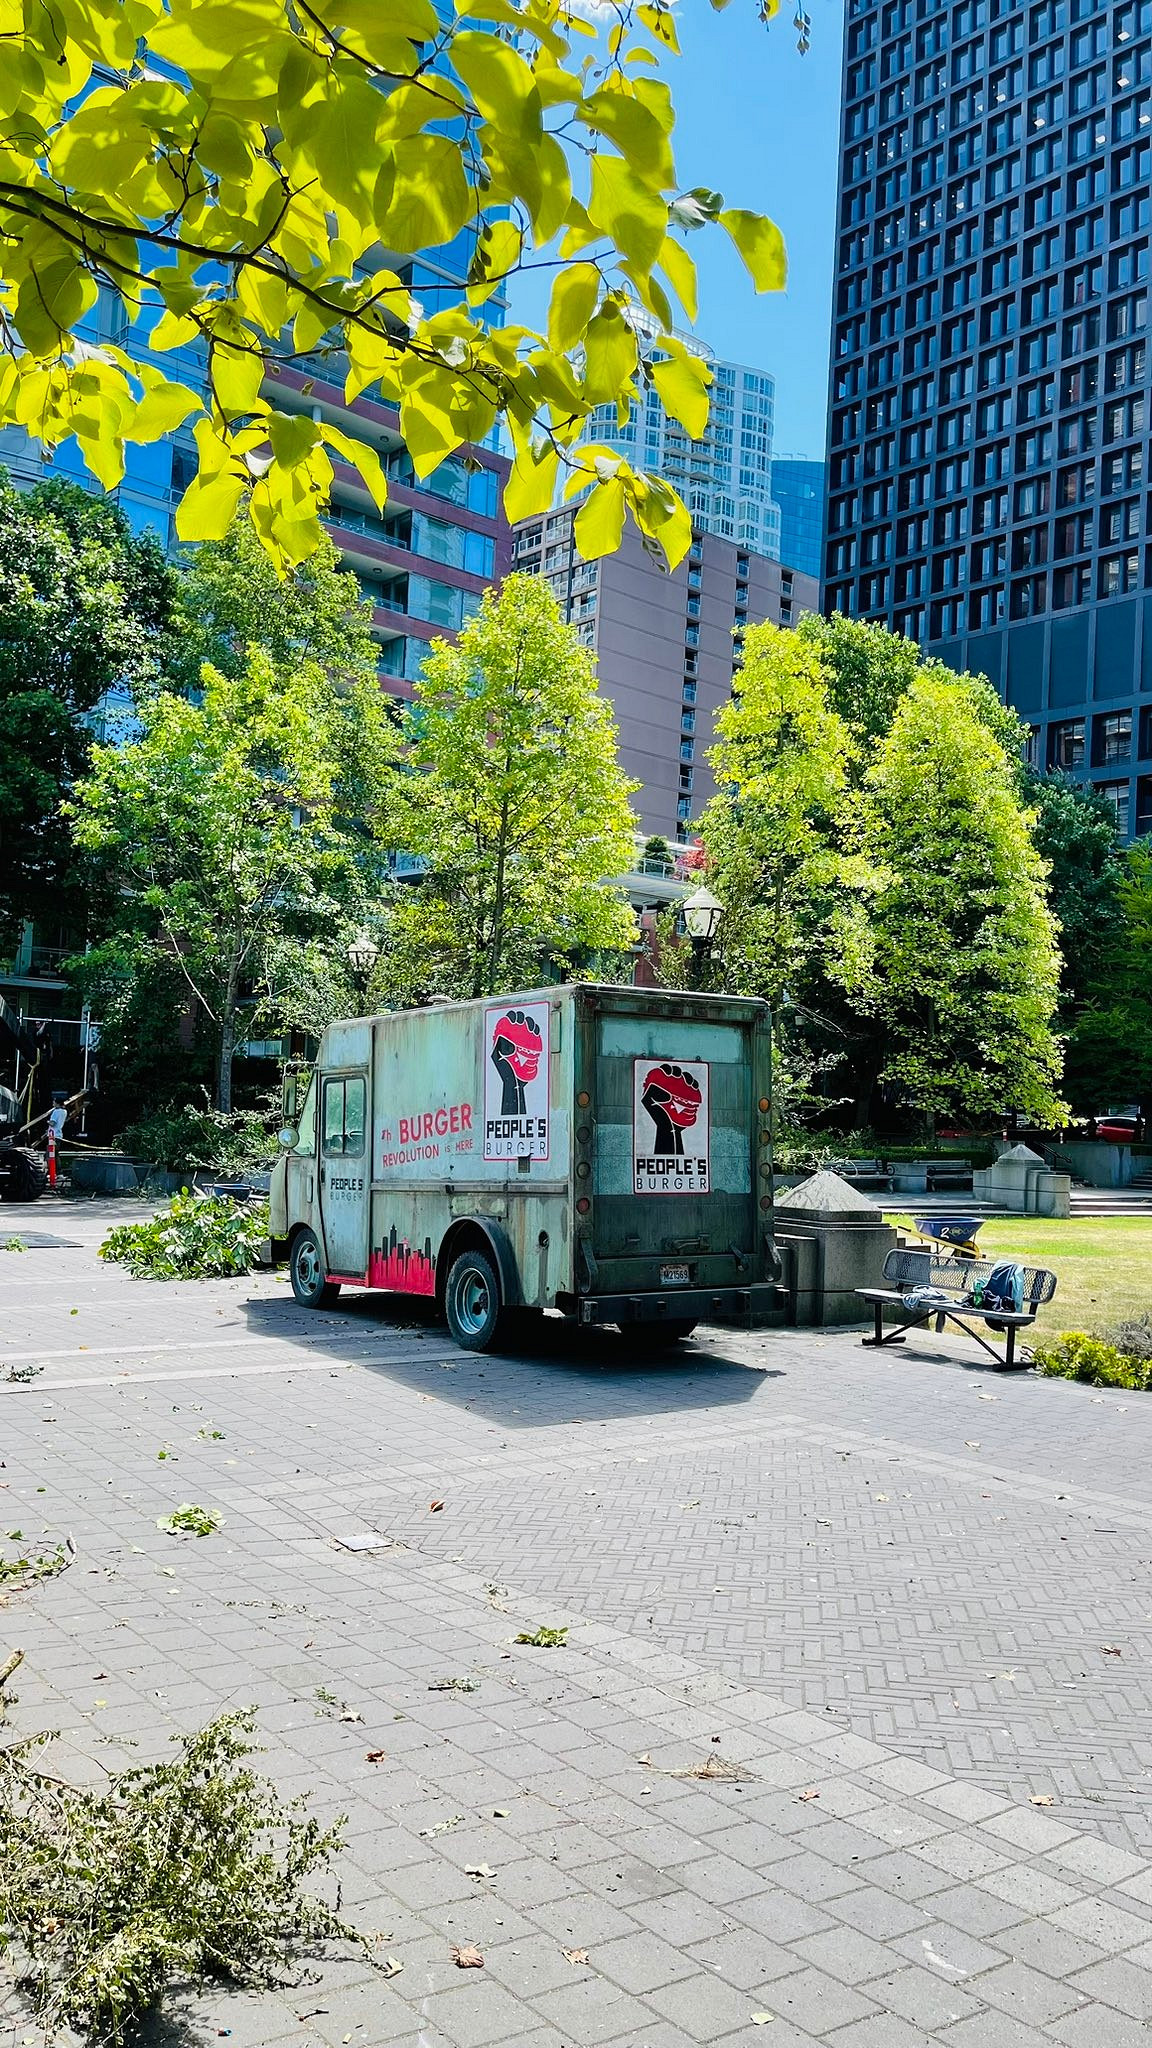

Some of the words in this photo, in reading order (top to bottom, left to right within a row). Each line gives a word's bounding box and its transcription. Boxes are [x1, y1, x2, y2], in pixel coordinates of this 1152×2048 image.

[399, 1103, 472, 1145] BURGER
[486, 1117, 546, 1139] PEOPLE'S
[382, 1144, 439, 1168] REVOLUTION
[455, 1139, 473, 1152] HERE
[486, 1141, 546, 1155] BURGER
[636, 1157, 707, 1175] PEOPLE'S
[636, 1177, 707, 1190] BURGER
[940, 1227, 950, 1239] 2
